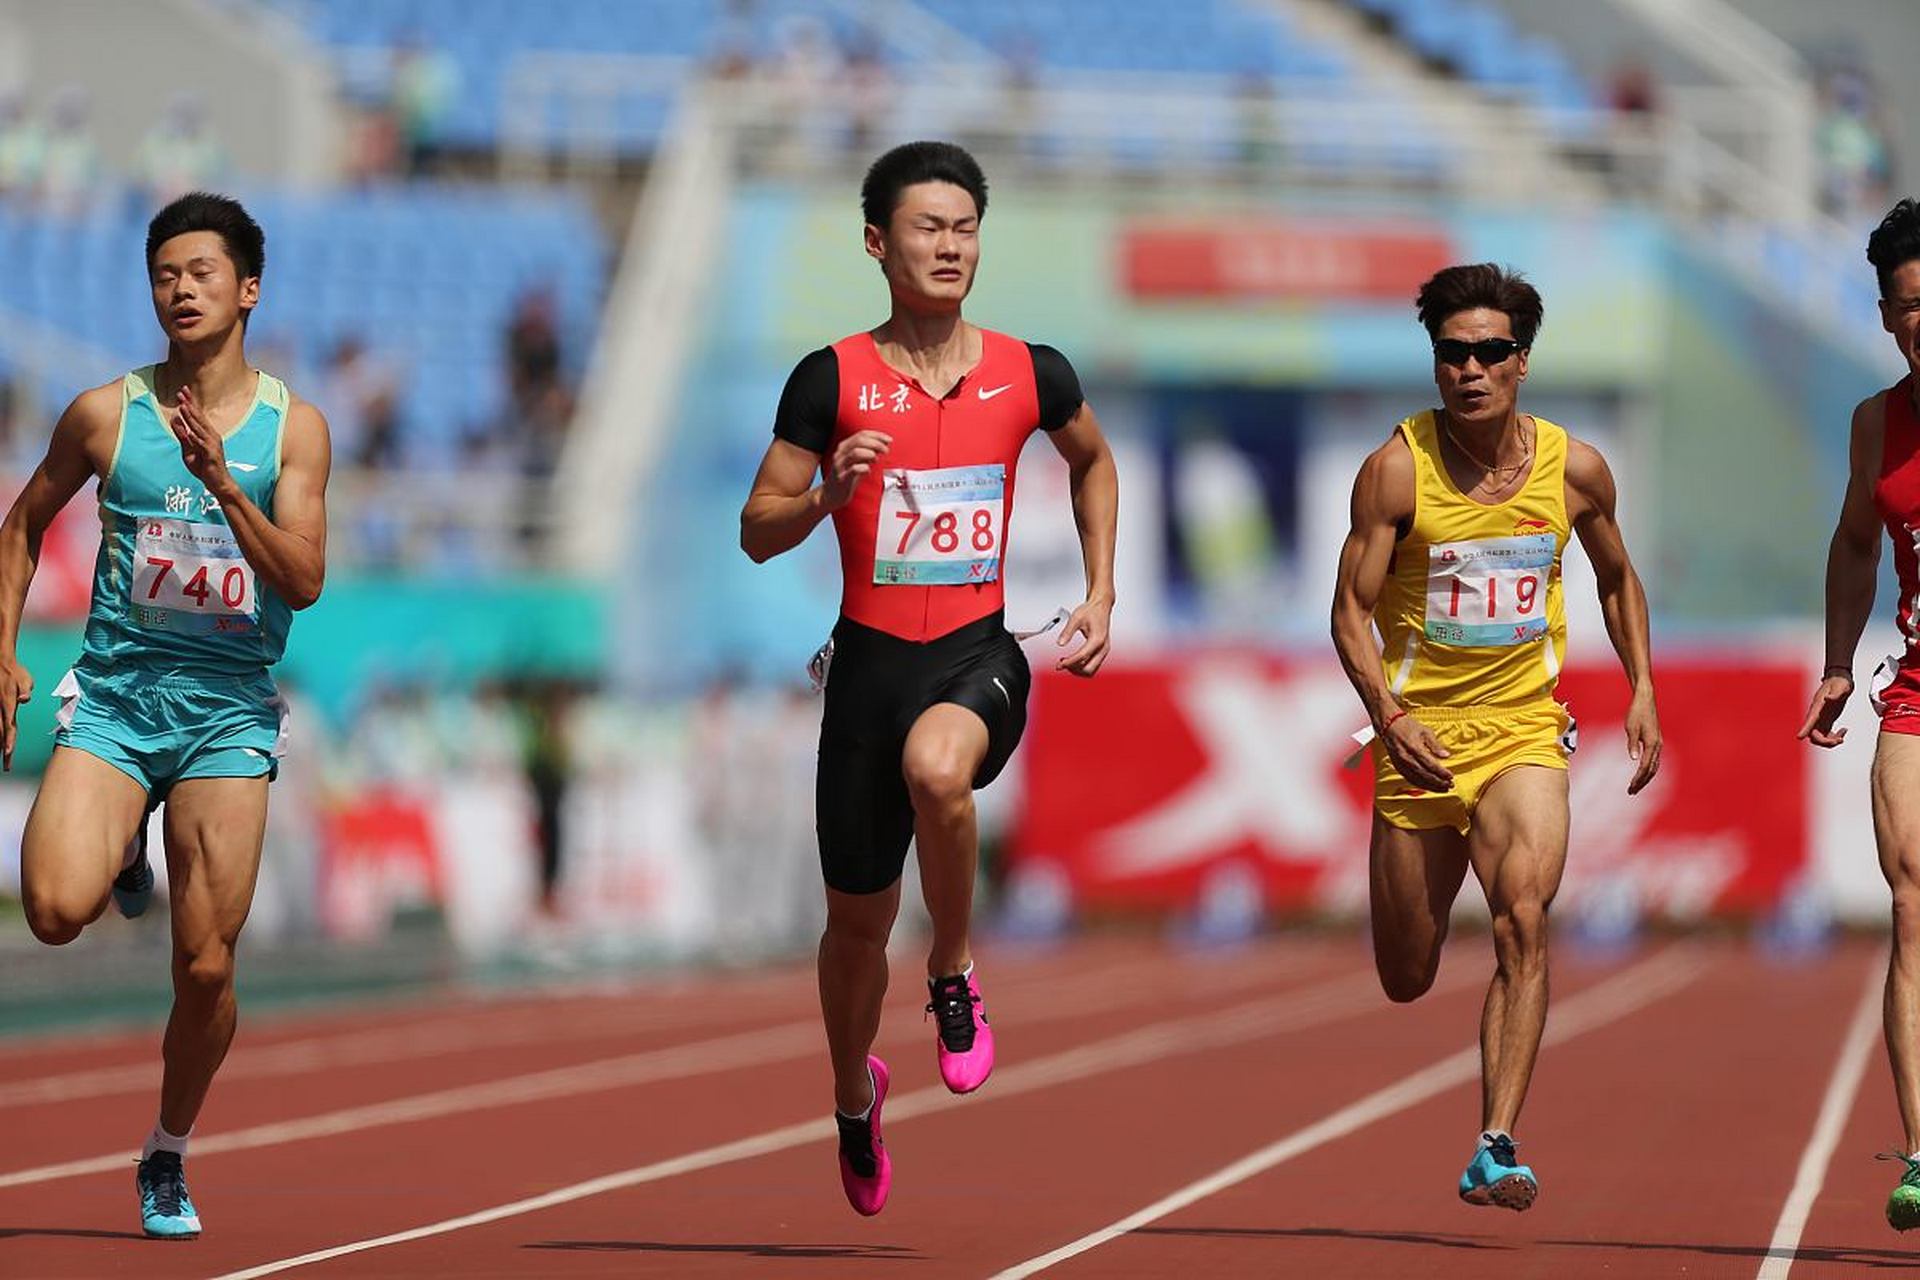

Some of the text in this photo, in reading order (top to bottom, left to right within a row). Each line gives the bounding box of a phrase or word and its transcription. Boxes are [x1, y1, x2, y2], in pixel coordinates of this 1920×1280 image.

[858, 383, 912, 413] 北京
[164, 484, 221, 517] 浙江
[896, 508, 995, 554] 788
[146, 556, 245, 609] 740
[1449, 575, 1538, 618] 119
